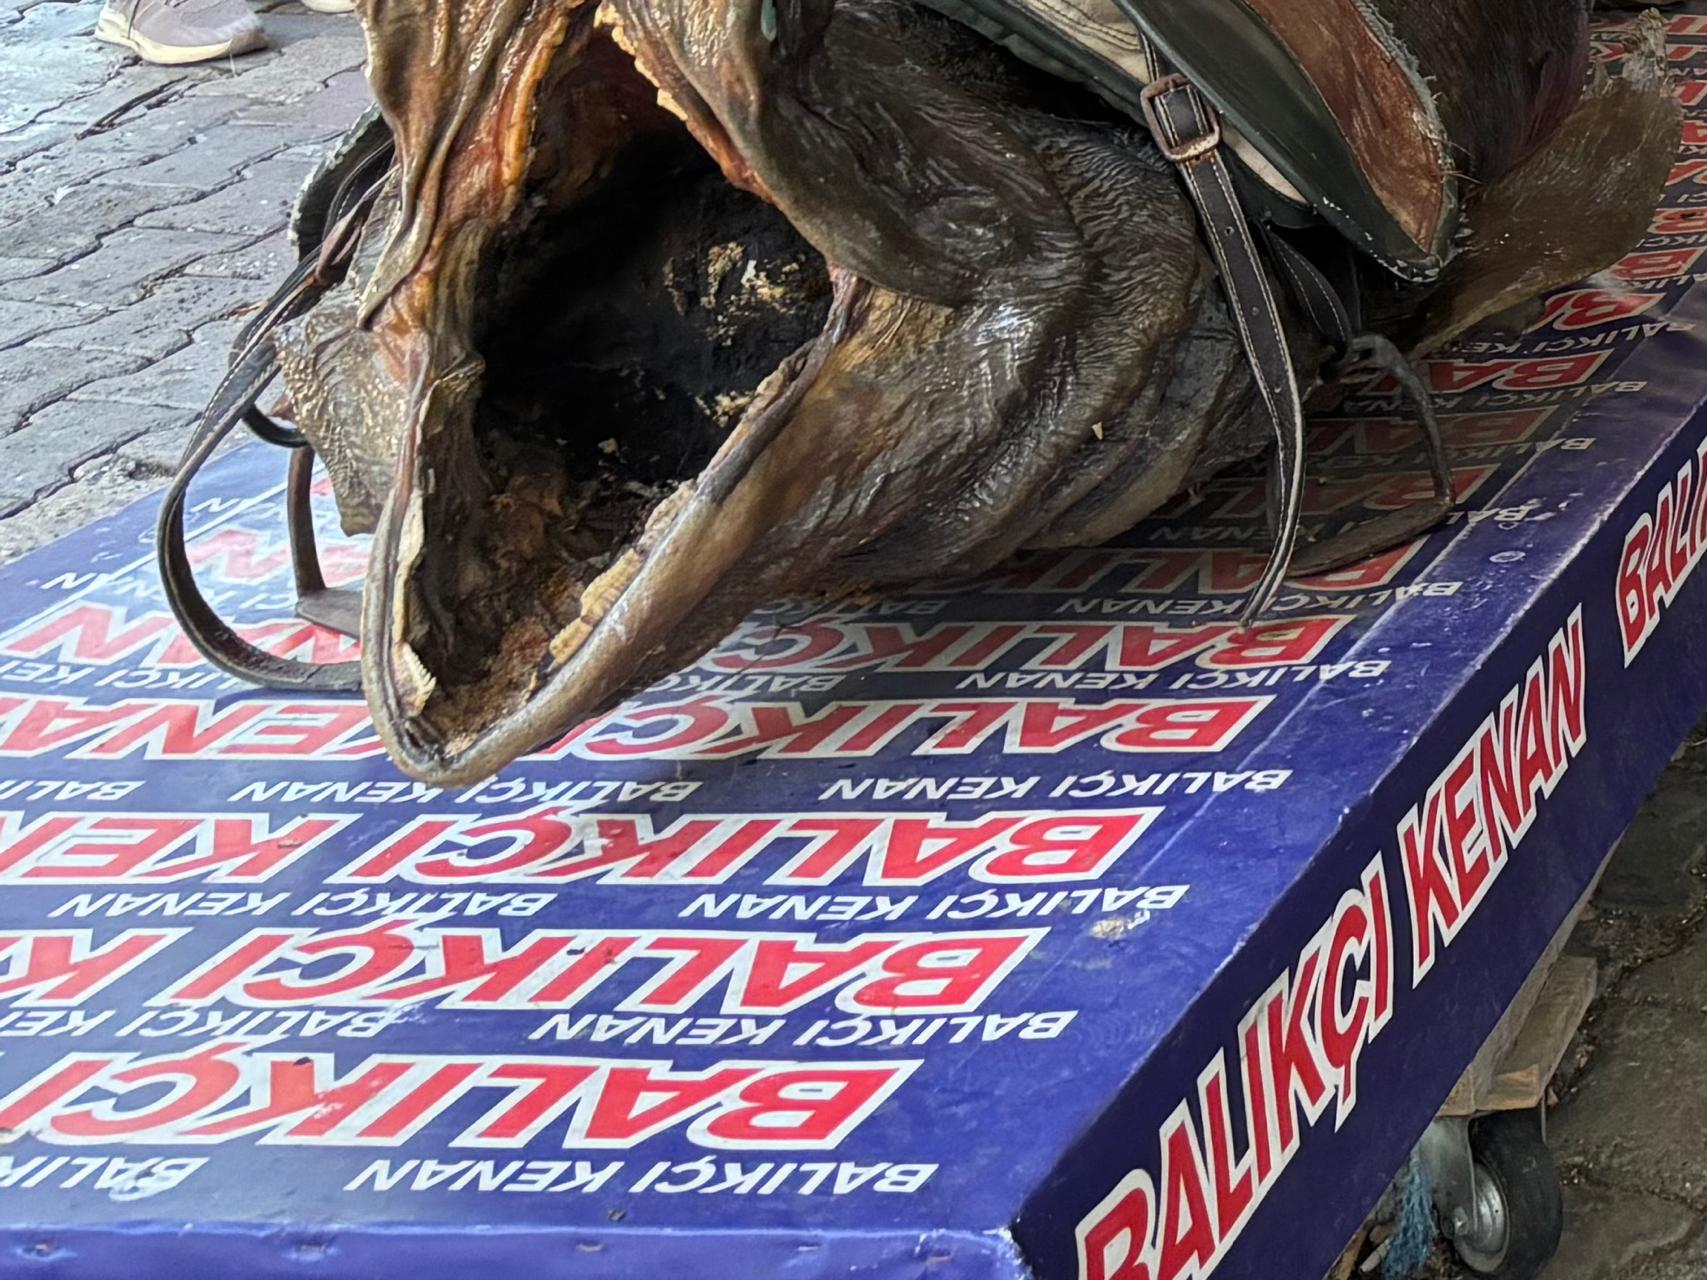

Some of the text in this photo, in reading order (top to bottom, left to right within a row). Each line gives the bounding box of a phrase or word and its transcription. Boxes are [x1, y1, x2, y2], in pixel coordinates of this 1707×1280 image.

[1055, 597, 1239, 617] KENAN
[955, 659, 1391, 692] BALIKÇI KENAN
[816, 769, 1292, 803] BALIKÇI KENAN
[325, 804, 1166, 886] BALIKÇI
[48, 888, 559, 918] BALIKÇI KENAN
[678, 885, 1191, 920] BALIKÇI KENAN
[1074, 850, 1394, 1280] BALIKÇI
[1396, 603, 1589, 990] KENAN
[143, 915, 1051, 1016] BALIKÇI
[527, 1009, 1078, 1046] BALIKÇI KENAN
[0, 1034, 925, 1149] BALIKÇI
[343, 1155, 939, 1196] BALIKÇI KENAN
